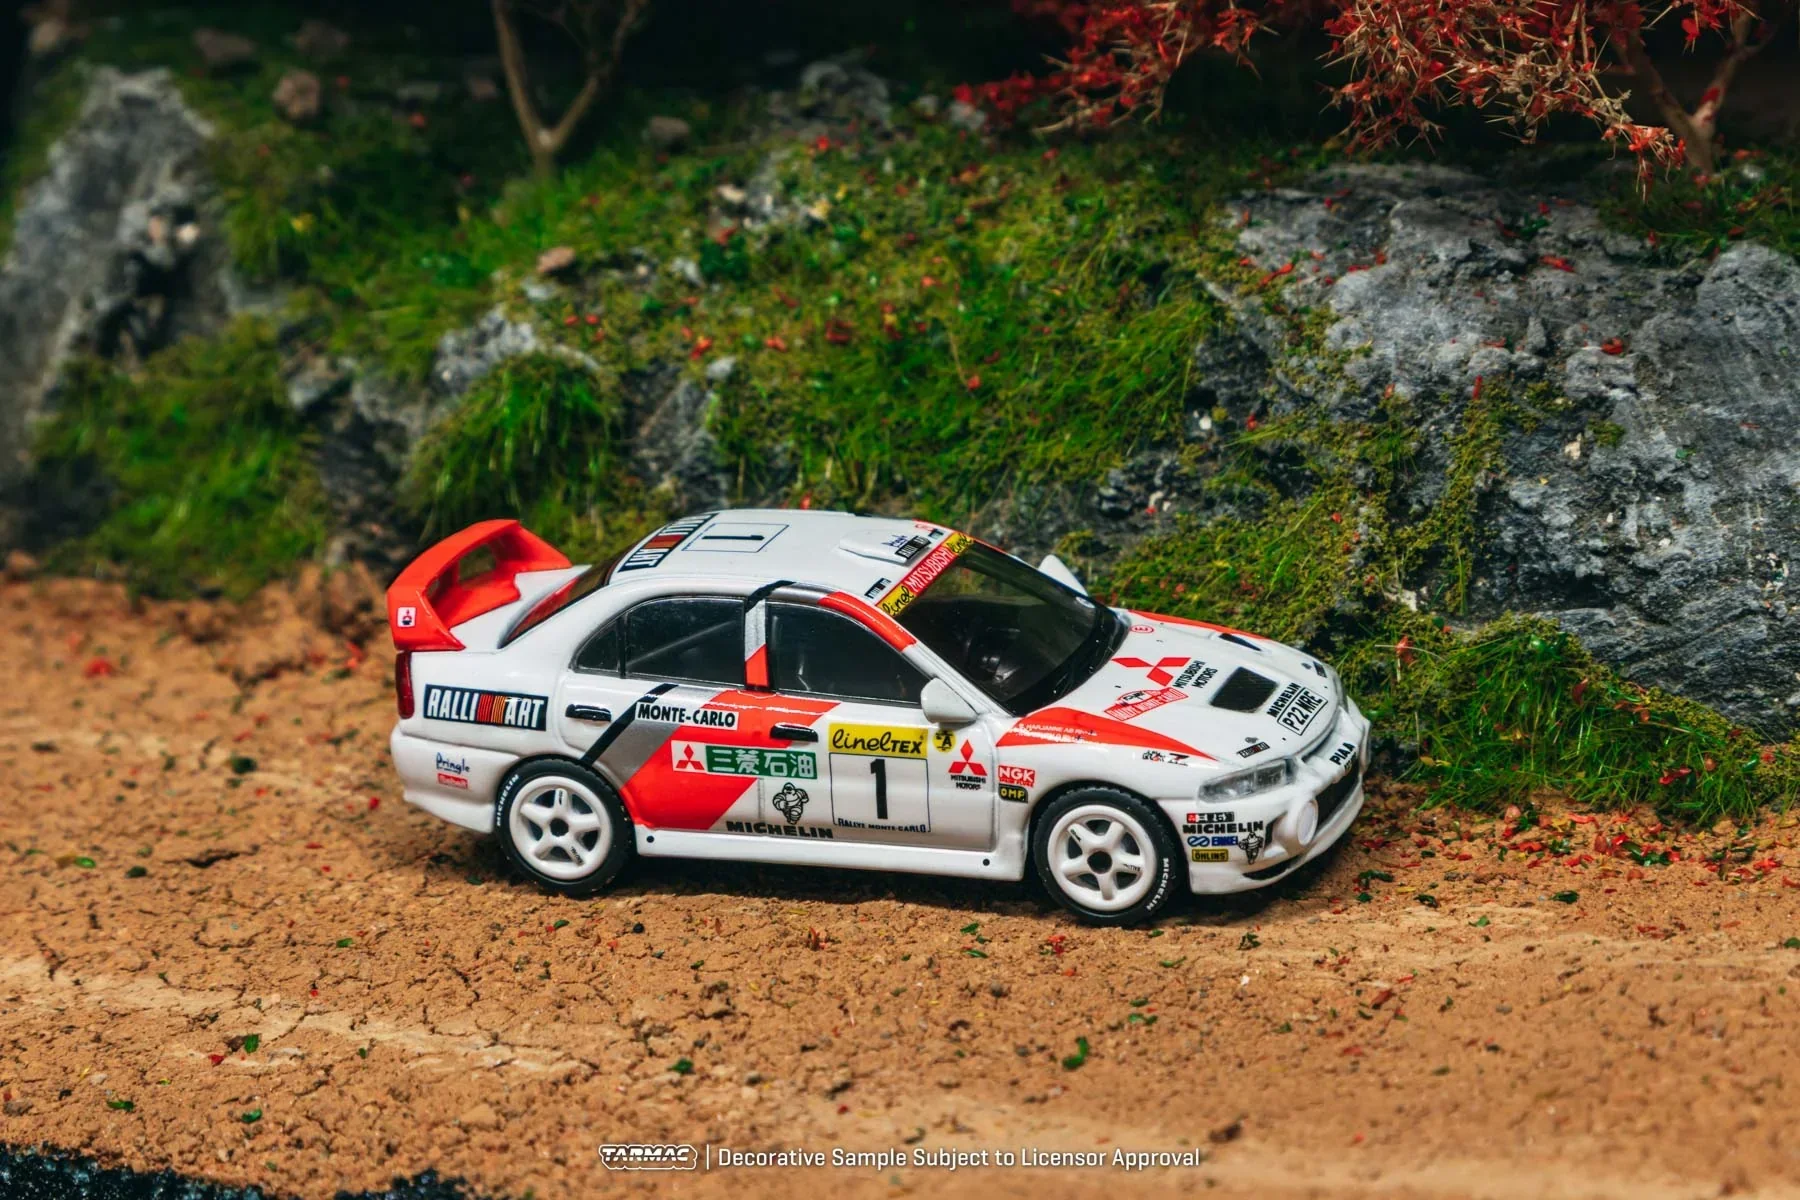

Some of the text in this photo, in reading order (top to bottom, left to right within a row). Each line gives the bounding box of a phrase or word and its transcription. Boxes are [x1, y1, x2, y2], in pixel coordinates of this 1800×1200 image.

[904, 546, 955, 593] MITSUBISHI
[1172, 660, 1206, 689] MITSUBISHI
[1191, 667, 1218, 689] MOTORS
[1266, 682, 1301, 717] MICHELIN
[1282, 705, 1309, 731] P22
[1296, 690, 1324, 714] MRE
[637, 703, 736, 728] MONTE-CARLO
[832, 728, 922, 755] linelTEX
[1329, 742, 1356, 766] PIAA
[711, 748, 815, 779] 三菱石油
[999, 766, 1034, 783] NGK
[870, 758, 888, 819] 1
[1000, 787, 1025, 799] OMP
[726, 821, 834, 839] MICHELIN
[1182, 821, 1264, 834] MICHELIN
[1146, 857, 1169, 911] MICHELIN
